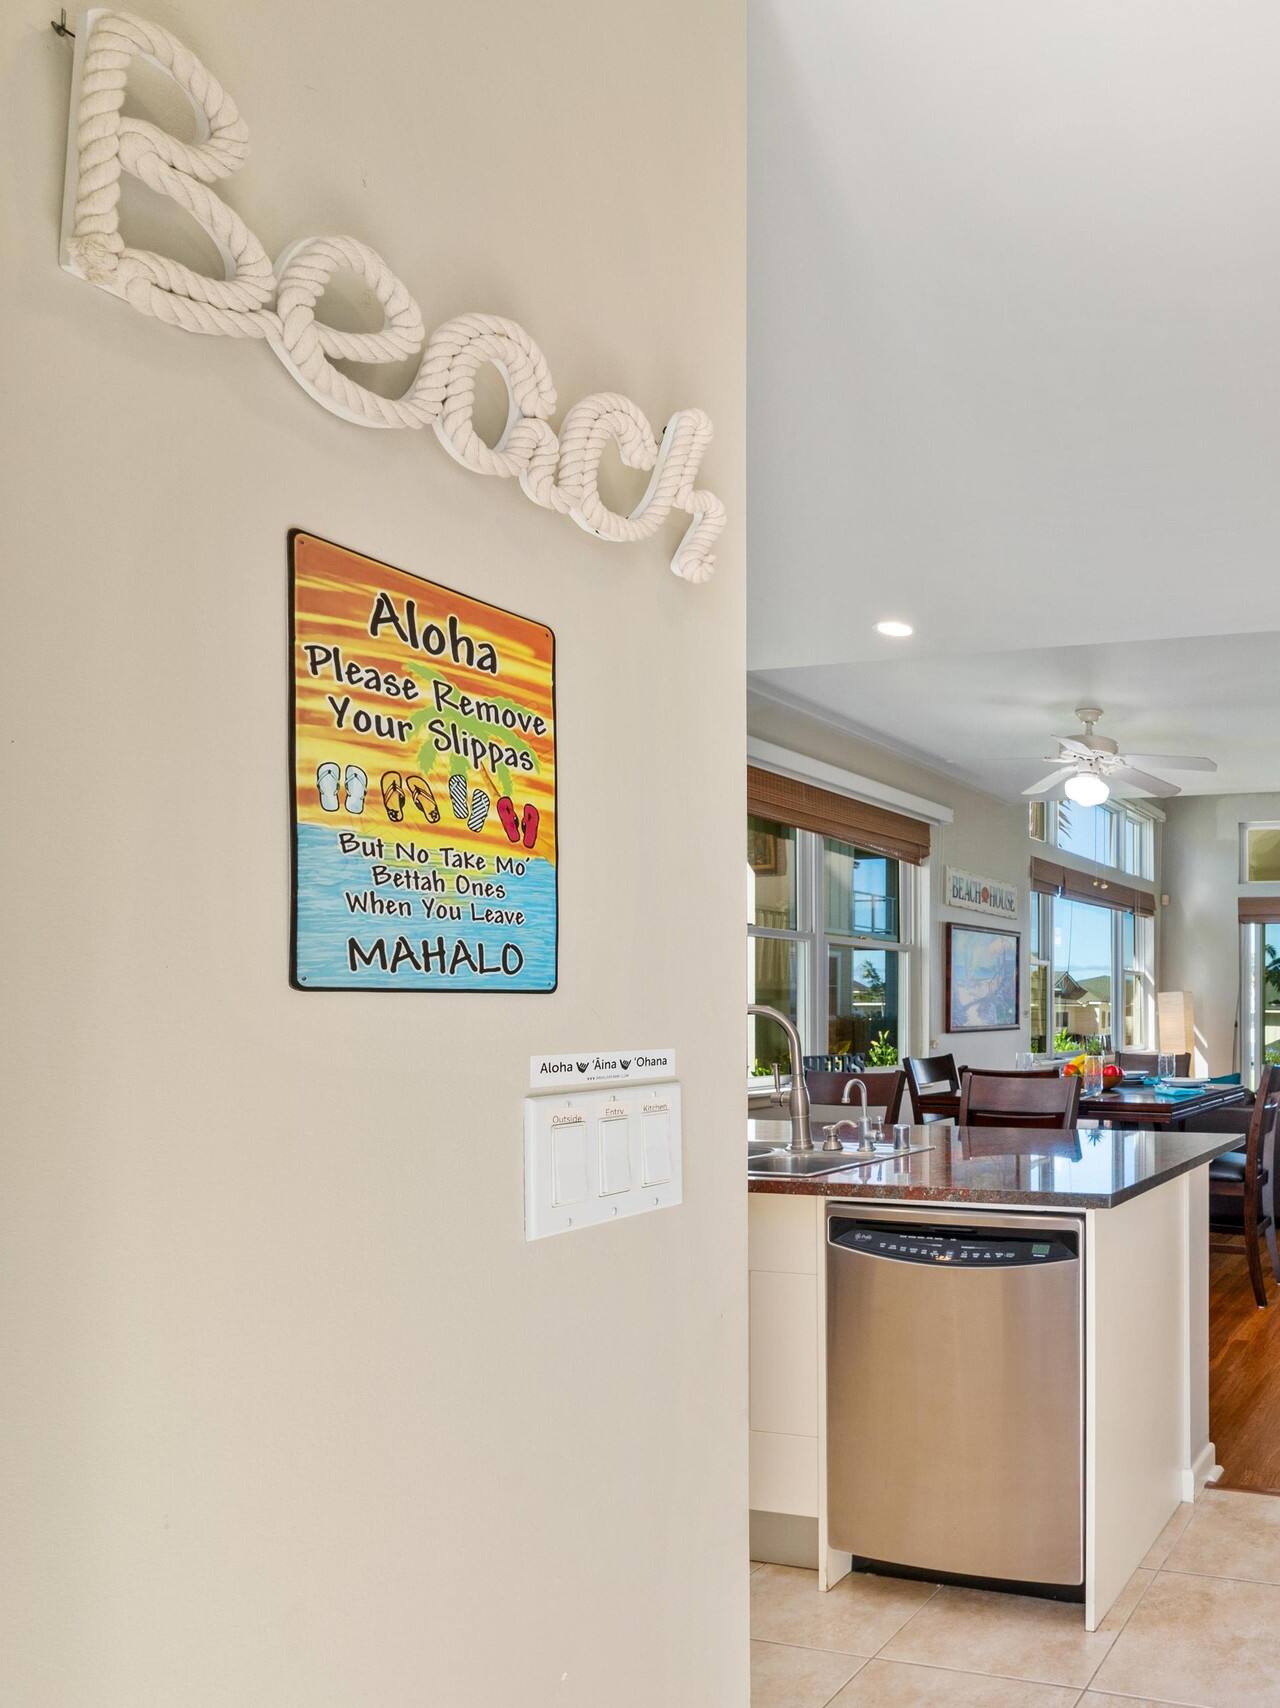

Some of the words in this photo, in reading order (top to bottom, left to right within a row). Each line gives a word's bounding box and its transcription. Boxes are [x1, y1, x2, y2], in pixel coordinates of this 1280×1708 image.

[370, 592, 498, 675] Aloha
[304, 645, 419, 701] Please
[433, 680, 547, 736] Remove
[328, 696, 413, 742] Your
[428, 719, 534, 772] Slippas
[339, 832, 384, 859] But
[396, 843, 430, 864] No
[439, 847, 486, 870] Take
[372, 865, 445, 893] Bettah
[456, 875, 506, 899] Ones
[952, 875, 981, 904] BEACH
[989, 885, 1016, 912] HOUSE
[345, 892, 412, 917] When
[422, 899, 462, 921] You
[471, 903, 525, 925] Leave
[348, 936, 525, 976] MAHALO
[540, 1062, 573, 1074] Aloha
[552, 1115, 583, 1124] Outside
[605, 1108, 625, 1116] Entry
[642, 1103, 668, 1112] Kitchen
